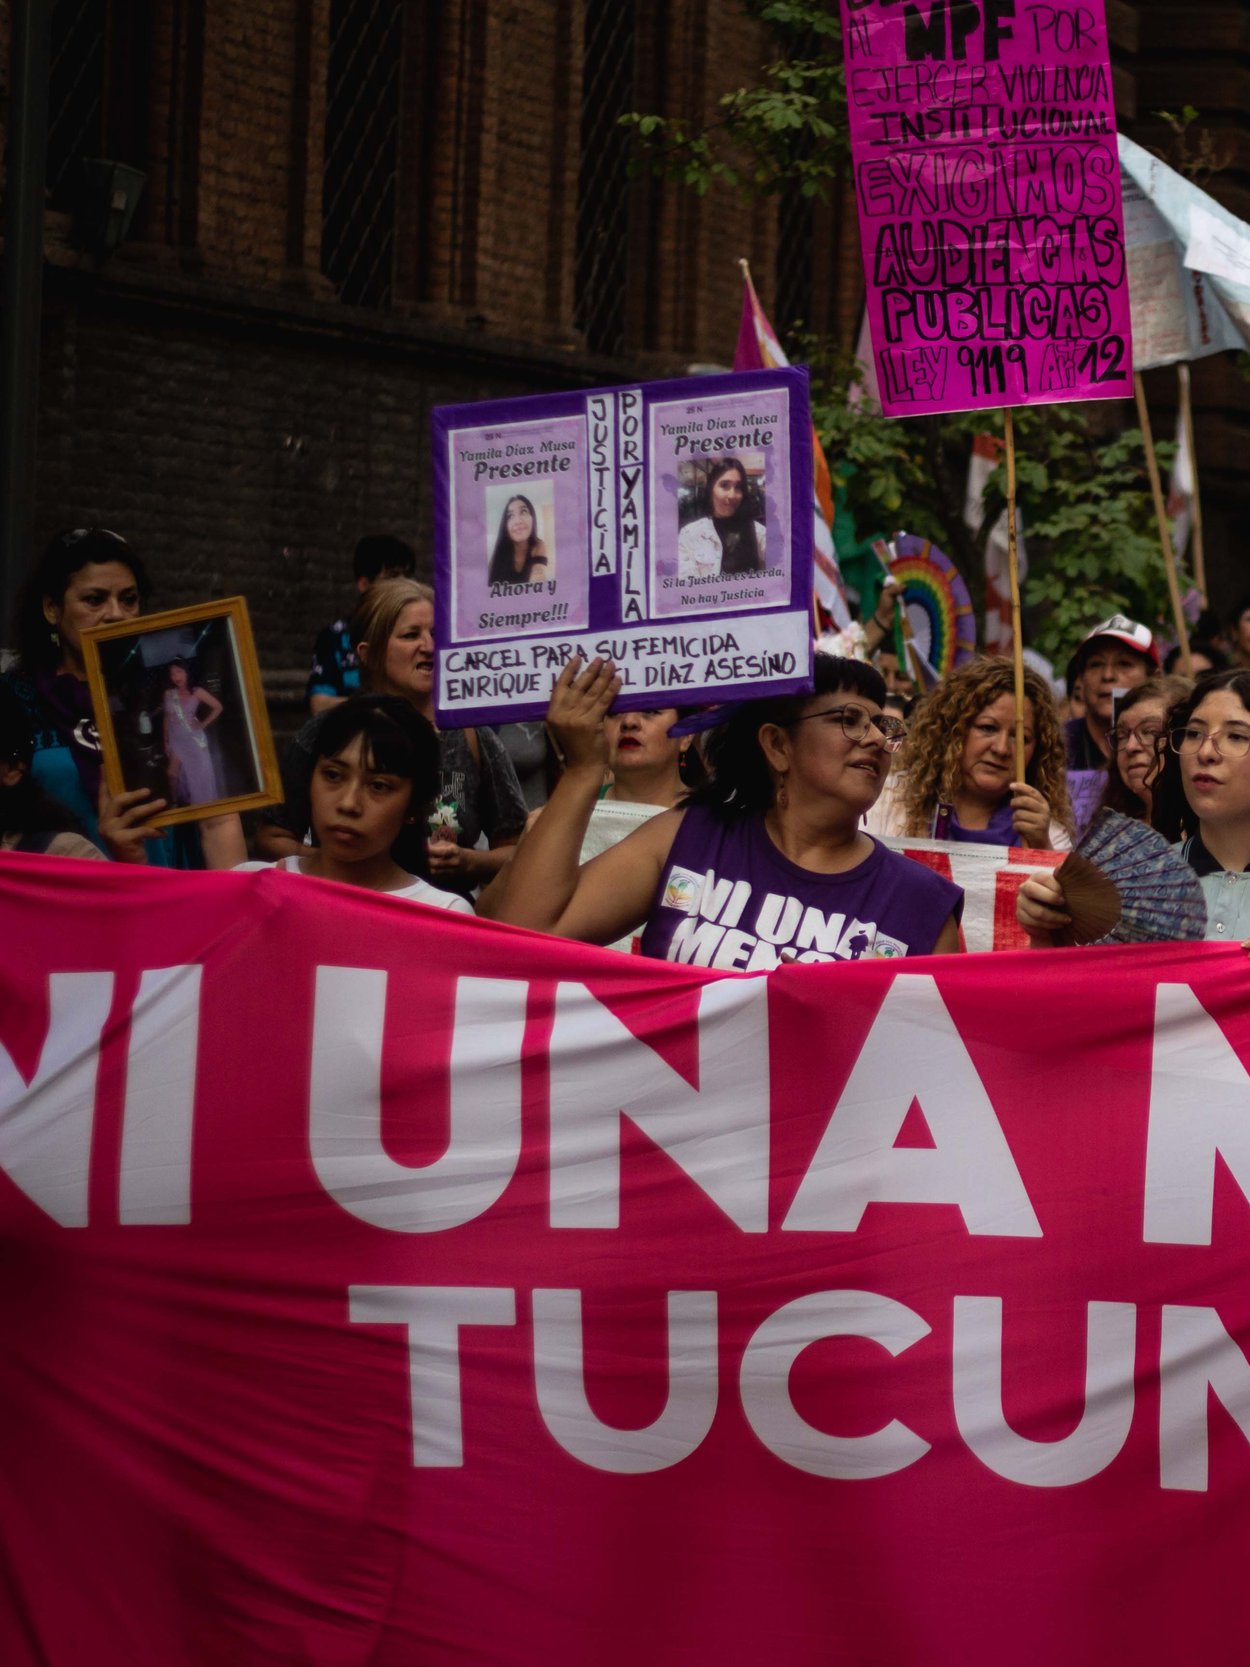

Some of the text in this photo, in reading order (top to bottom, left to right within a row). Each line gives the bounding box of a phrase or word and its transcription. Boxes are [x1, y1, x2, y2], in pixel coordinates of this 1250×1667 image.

[1025, 5, 1099, 54] POR
[850, 63, 1110, 108] EJERCER VIOLENCIA
[869, 103, 1117, 146] INSTITUCIONAL
[857, 144, 1116, 218] EXIGIMOS
[874, 214, 1125, 289] AUDIENCIAS
[882, 285, 1111, 344] PUBLICAS
[622, 392, 640, 463] POR
[660, 412, 779, 437] Yamila Díaz Musa
[674, 428, 773, 456] Presente
[459, 446, 503, 464] Yamila
[540, 439, 576, 453] Musa
[474, 454, 571, 482] Presente
[489, 579, 557, 600] Ahora y
[681, 587, 765, 606] No hay Justicia
[445, 632, 740, 674] CARCEL PARA SU FEMICIDA
[686, 868, 878, 960] NI UNA
[0, 964, 204, 1228] NI
[308, 964, 1044, 1238] UNA
